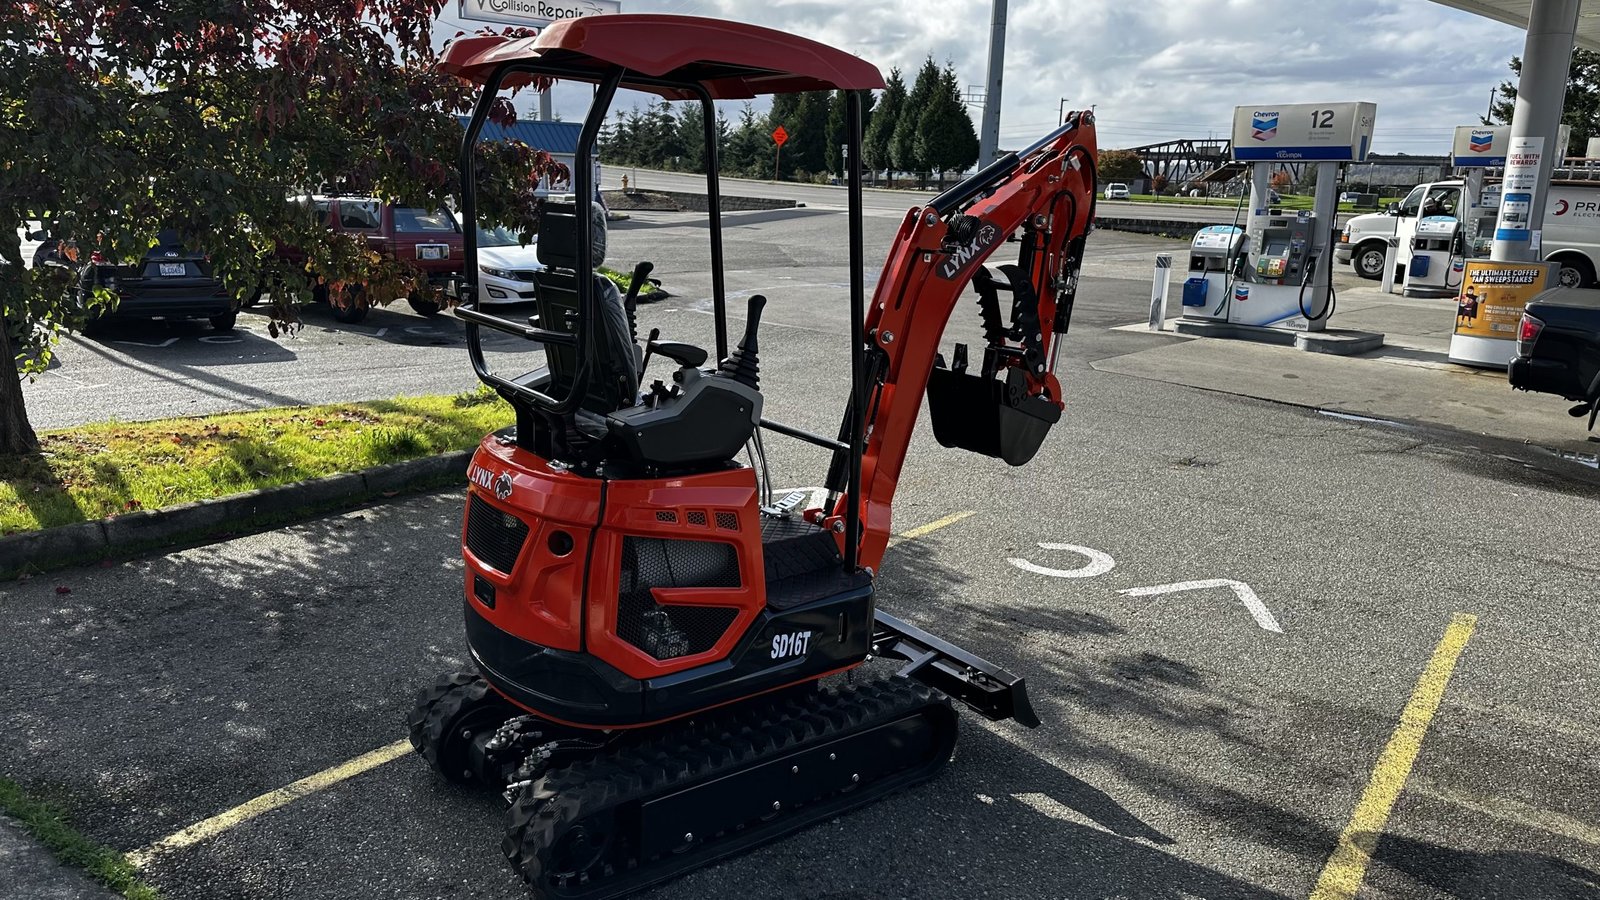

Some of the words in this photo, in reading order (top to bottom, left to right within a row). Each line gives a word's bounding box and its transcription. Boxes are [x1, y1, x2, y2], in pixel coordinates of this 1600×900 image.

[538, 1, 583, 20] Repair
[1311, 110, 1334, 128] 12
[943, 237, 980, 278] LYNX
[471, 465, 495, 490] LYNX
[771, 631, 811, 659] SD16T
